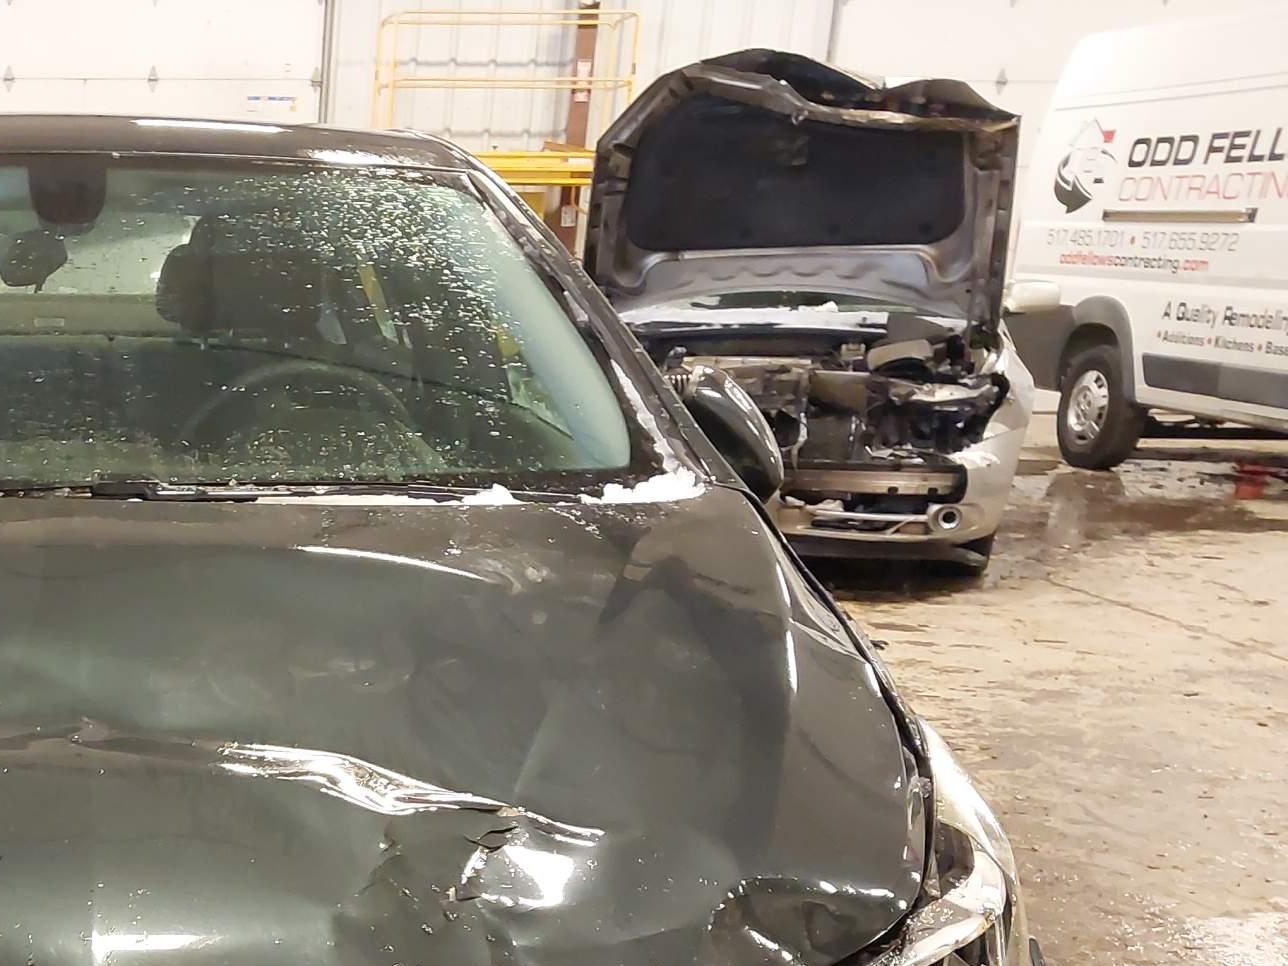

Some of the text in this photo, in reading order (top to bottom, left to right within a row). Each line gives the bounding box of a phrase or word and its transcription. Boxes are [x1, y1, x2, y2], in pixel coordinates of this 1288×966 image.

[1128, 127, 1286, 168] ODD FELL
[1161, 301, 1172, 320] A
[1176, 302, 1217, 328] Quality
